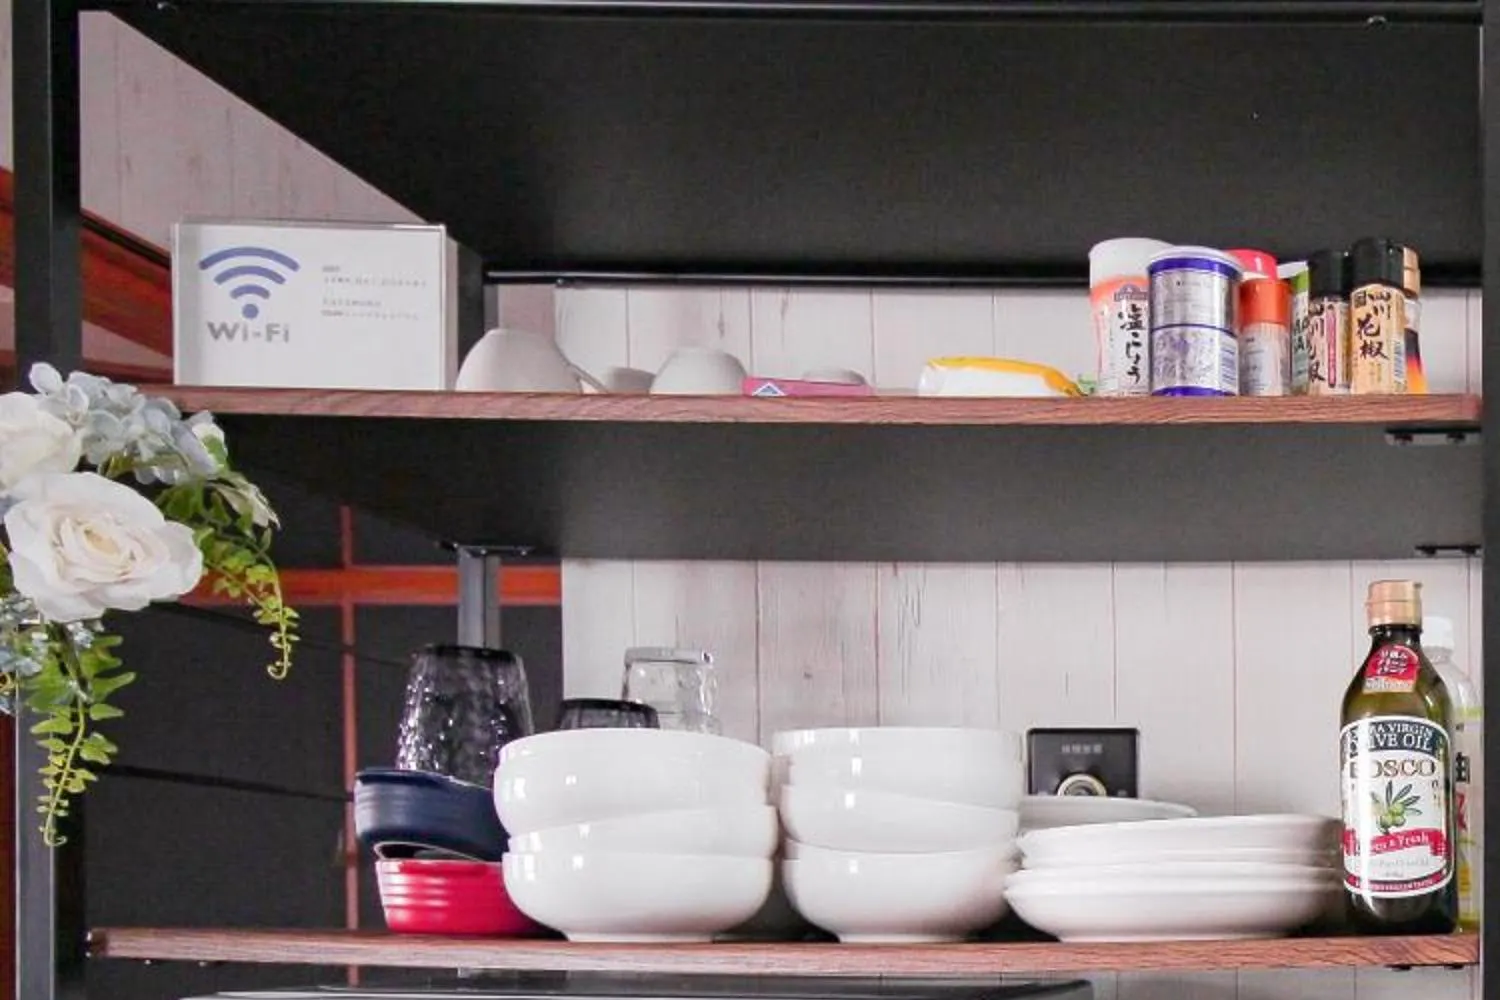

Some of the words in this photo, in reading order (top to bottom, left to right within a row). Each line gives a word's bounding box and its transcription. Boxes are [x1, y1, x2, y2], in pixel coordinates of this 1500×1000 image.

[207, 321, 290, 343] Wi-Fi
[1390, 723, 1433, 738] VIRGIN
[1403, 733, 1433, 751] OIL
